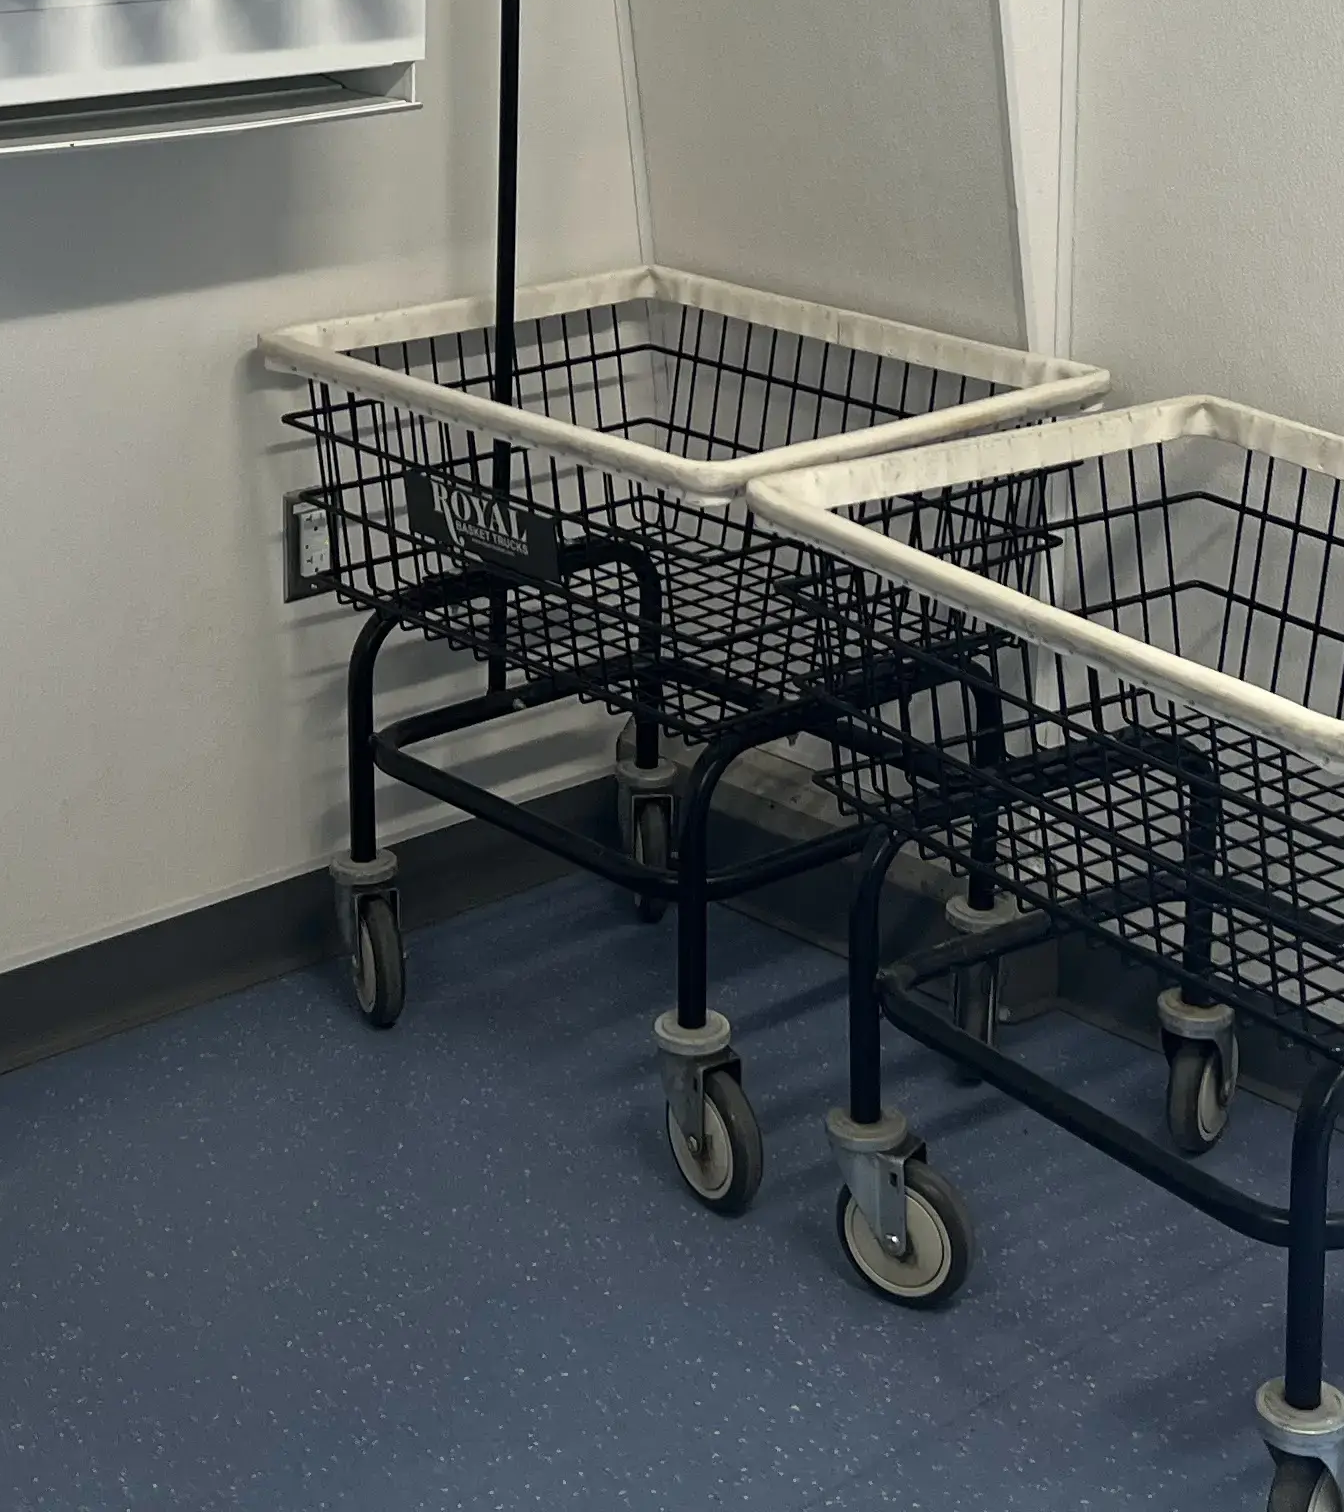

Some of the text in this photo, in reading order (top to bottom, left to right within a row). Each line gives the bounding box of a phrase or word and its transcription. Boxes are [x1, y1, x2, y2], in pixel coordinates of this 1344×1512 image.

[431, 479, 528, 547] ROYAL
[456, 519, 490, 541] BASKET
[492, 532, 529, 556] TRUCKS
